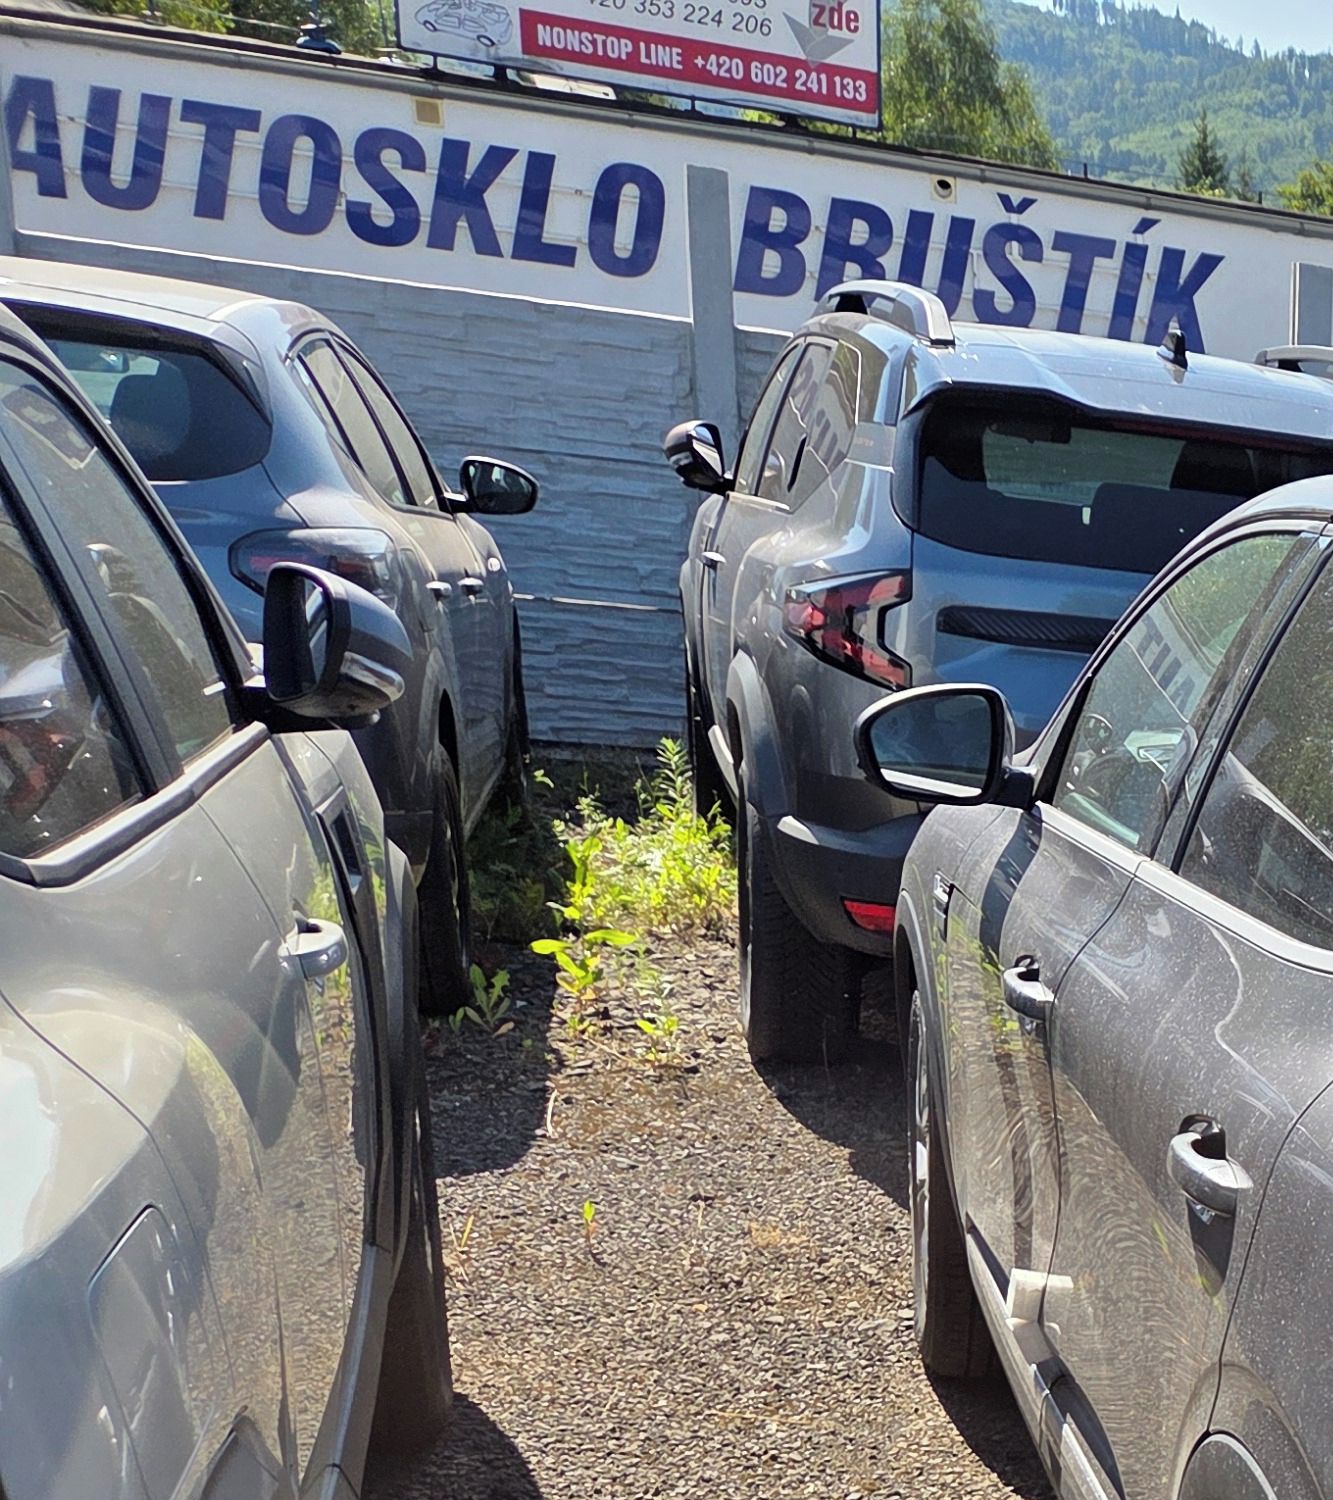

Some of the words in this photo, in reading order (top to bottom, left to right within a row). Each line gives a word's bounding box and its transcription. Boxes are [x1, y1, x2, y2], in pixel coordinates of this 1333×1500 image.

[635, 0, 674, 18] 353
[683, 4, 722, 28] 224
[731, 12, 772, 36] 206
[810, 1, 860, 34] zde
[537, 23, 633, 60] NONSTOP
[639, 41, 683, 70] LINE
[694, 54, 744, 80] +420
[750, 61, 788, 88] 602
[794, 68, 827, 95] 241
[833, 75, 867, 102] 133
[4, 74, 666, 278] AUTOSKLO
[733, 185, 1226, 355] BRUŠTÍK
